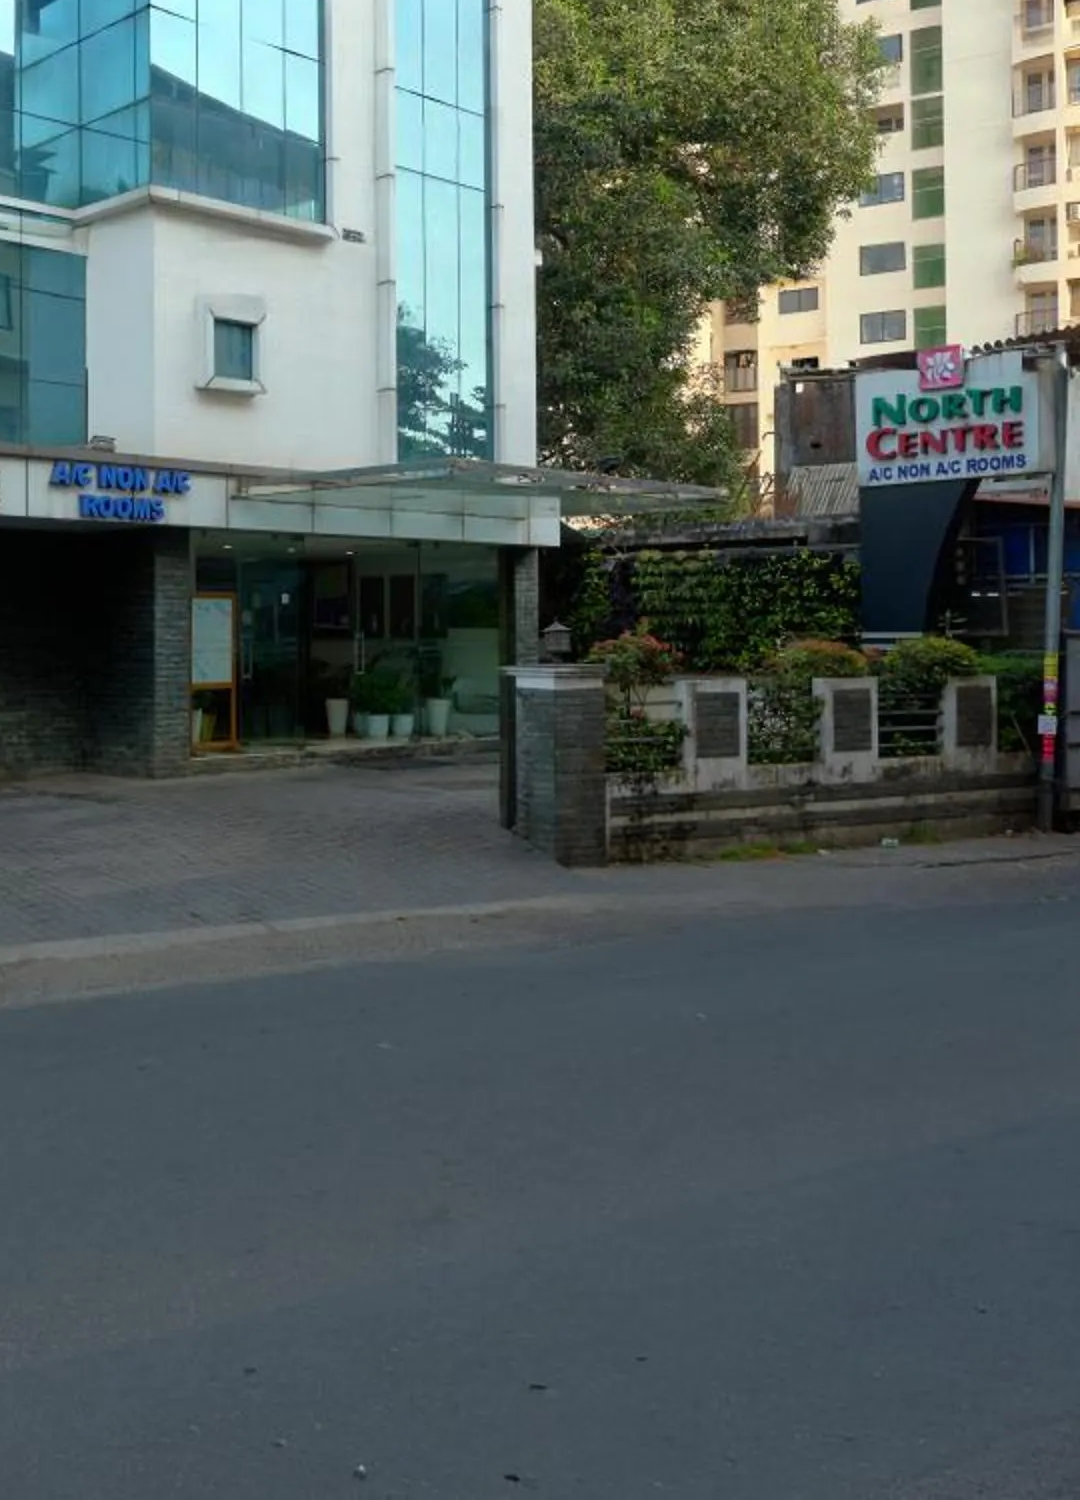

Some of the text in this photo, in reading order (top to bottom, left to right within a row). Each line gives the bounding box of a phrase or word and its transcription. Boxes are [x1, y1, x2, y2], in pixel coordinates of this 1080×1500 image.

[871, 385, 1023, 428] NORTH
[865, 421, 1025, 462] CENTRE
[49, 460, 191, 494] A/C NON A/C
[869, 453, 1028, 482] A/C NON A/C ROOMS
[79, 494, 165, 521] ROOMS
